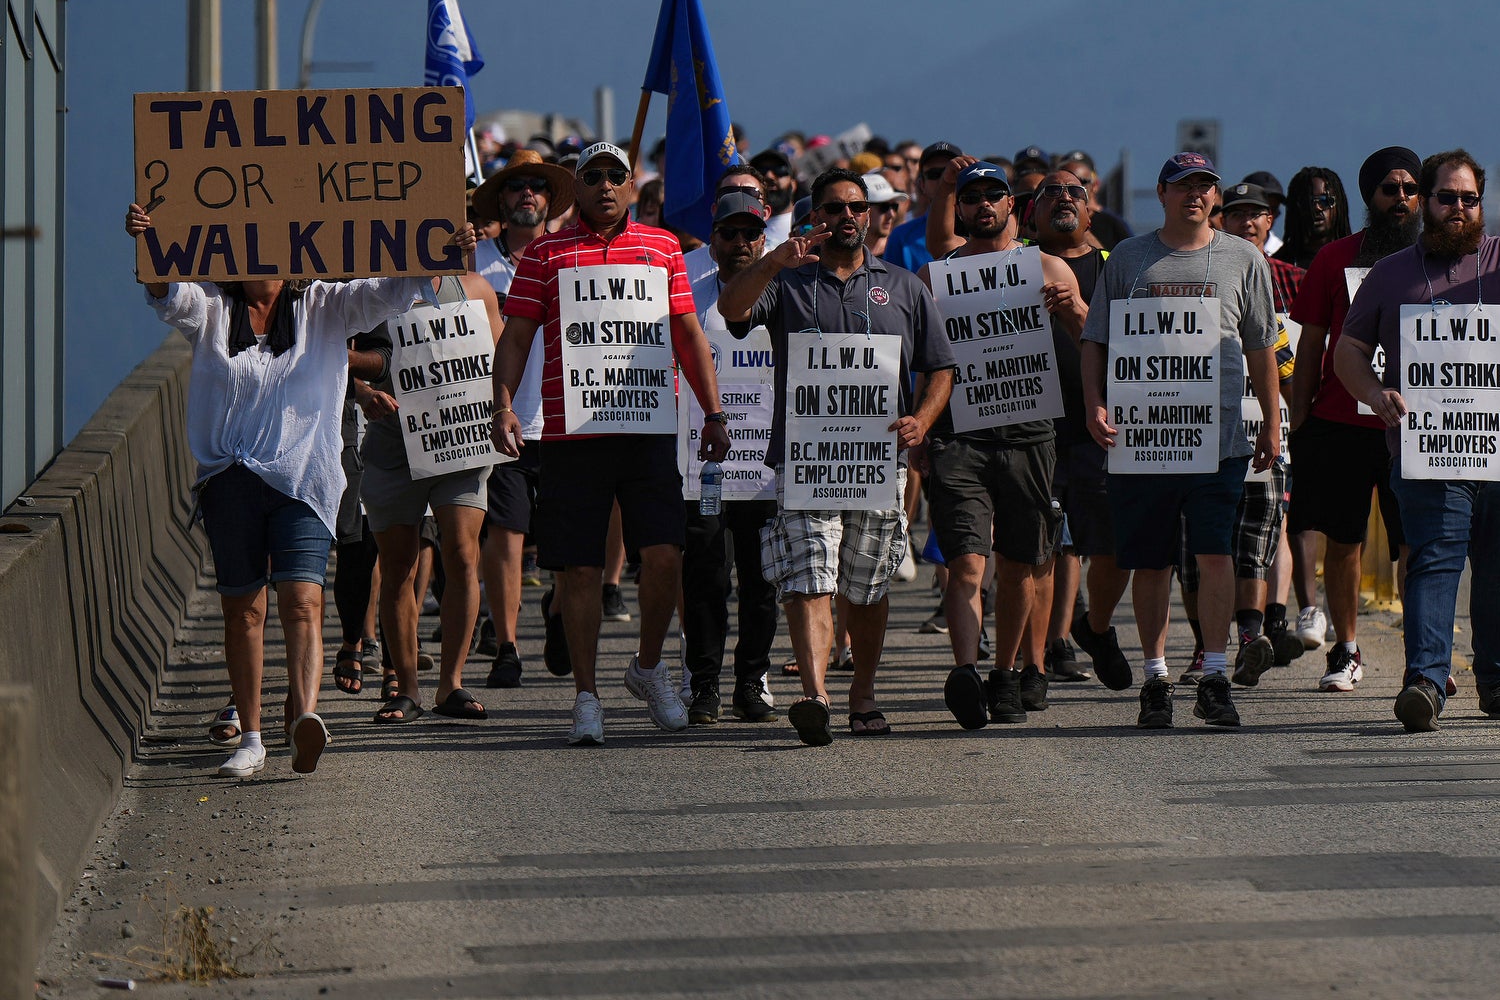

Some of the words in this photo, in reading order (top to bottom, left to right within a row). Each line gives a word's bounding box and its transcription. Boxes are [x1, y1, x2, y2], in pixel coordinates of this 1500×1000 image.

[150, 92, 453, 149] TALKING
[587, 143, 619, 156] ROOTS
[194, 163, 273, 209] OR
[318, 161, 421, 203] KEEP
[144, 218, 464, 277] WALKING
[575, 278, 653, 302] I.L.W.U.
[946, 264, 1027, 296] I.L.W.U.
[1151, 285, 1213, 296] NAUTICA
[397, 315, 476, 348] I.L.W.U.
[600, 320, 665, 346] STRIKE
[945, 316, 973, 342] ON
[976, 305, 1044, 337] STRIKE
[1124, 312, 1203, 336] I.L.W.U.
[1416, 318, 1497, 342] I.L.W.U.
[732, 350, 775, 367] ILWU
[807, 346, 879, 370] I.L.W.U.
[982, 344, 1014, 354] AGAINST
[398, 364, 427, 392] ON
[428, 353, 493, 386] STRIKE
[570, 368, 600, 387] B.C.
[604, 368, 668, 387] MARITIME
[953, 364, 982, 385] B.C.
[985, 352, 1051, 380] MARITIME
[1115, 356, 1141, 380] ON
[1146, 356, 1213, 380] STRIKE
[1408, 362, 1435, 387] ON
[436, 391, 467, 402] AGAINST
[582, 389, 659, 409] EMPLOYERS
[721, 393, 761, 404] STRIKE
[795, 385, 820, 416] ON
[827, 385, 889, 416] STRIKE
[965, 376, 1044, 405] EMPLOYERS
[406, 411, 437, 434] B.C.
[439, 399, 493, 427] MARITIM
[592, 411, 651, 422] ASSOCIATION
[726, 413, 748, 421] AINST
[978, 399, 1037, 417] ASSOCIATION
[1114, 405, 1143, 424] B.C.
[1148, 405, 1213, 424] MARITIME
[1408, 411, 1438, 431] B.C.
[420, 421, 493, 453] EMPLOYERS
[728, 429, 773, 440] ARITIME
[1125, 428, 1203, 448] EMPLOYERS
[1419, 434, 1497, 454] EMPLOYERS
[434, 443, 491, 464] ASSOCIATION
[697, 450, 764, 462] EOYERS
[790, 442, 816, 461] B.C.
[817, 442, 892, 461] MARITIME
[1134, 450, 1193, 462] ASSOCIATION
[1428, 456, 1488, 468] ASSOCIATION
[794, 464, 886, 485] EMPLOYERS
[812, 487, 867, 499] ASSOCIATION
